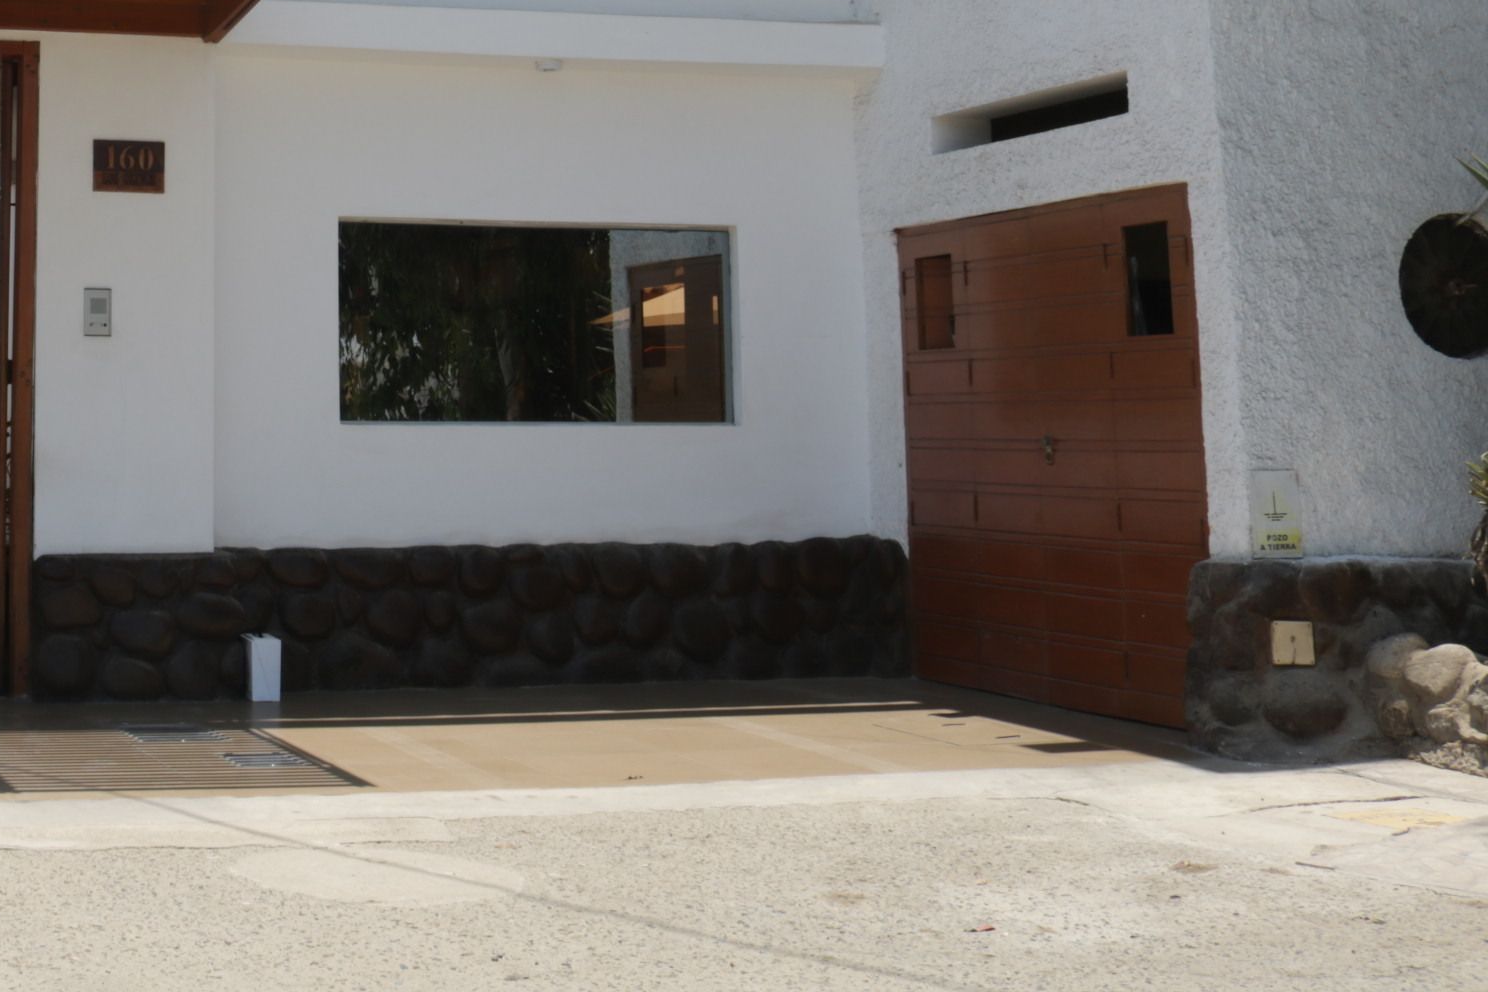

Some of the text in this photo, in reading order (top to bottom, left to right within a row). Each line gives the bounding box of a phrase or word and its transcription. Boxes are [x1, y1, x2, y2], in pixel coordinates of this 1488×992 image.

[106, 144, 156, 170] 160
[1266, 533, 1288, 541] POZO
[1268, 543, 1297, 551] TIERRA
